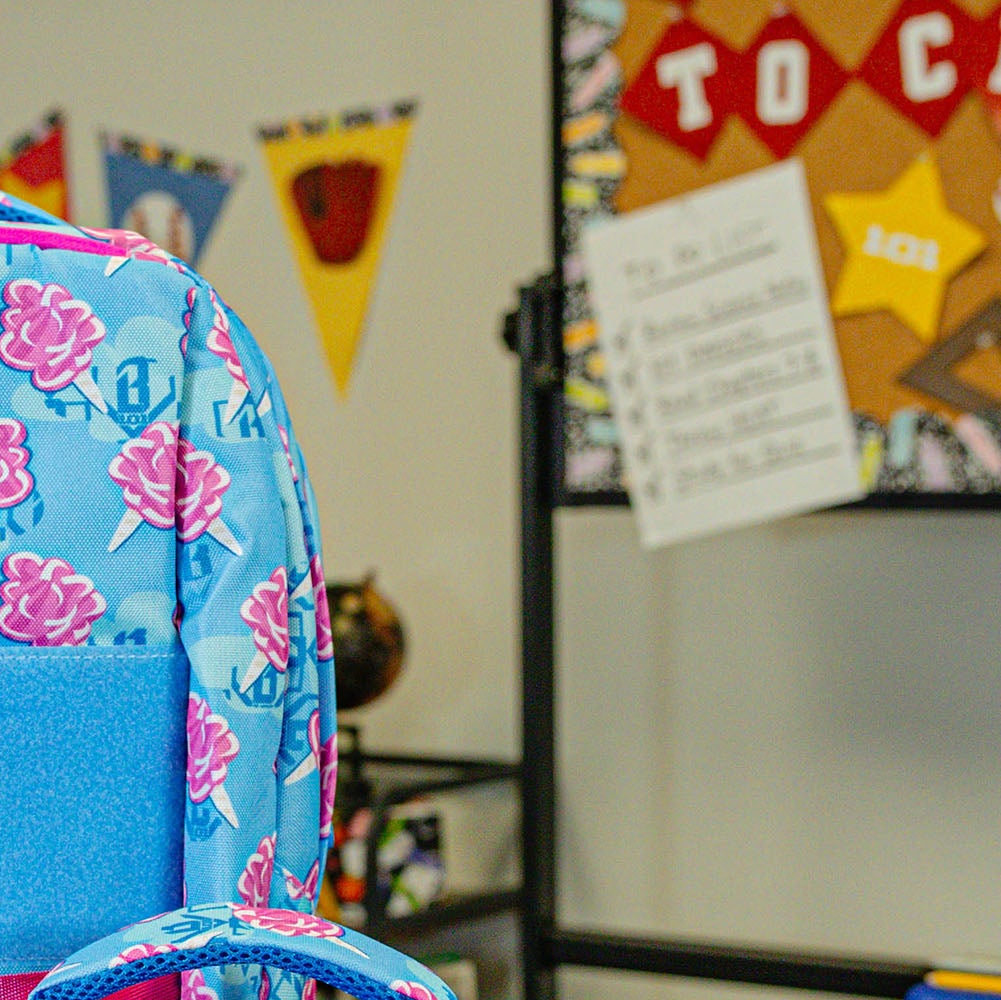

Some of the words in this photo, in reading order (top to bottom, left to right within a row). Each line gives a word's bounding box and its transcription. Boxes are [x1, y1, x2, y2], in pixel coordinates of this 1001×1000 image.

[656, 38, 810, 131] TO
[897, 11, 1001, 103] C
[863, 223, 939, 272] 101
